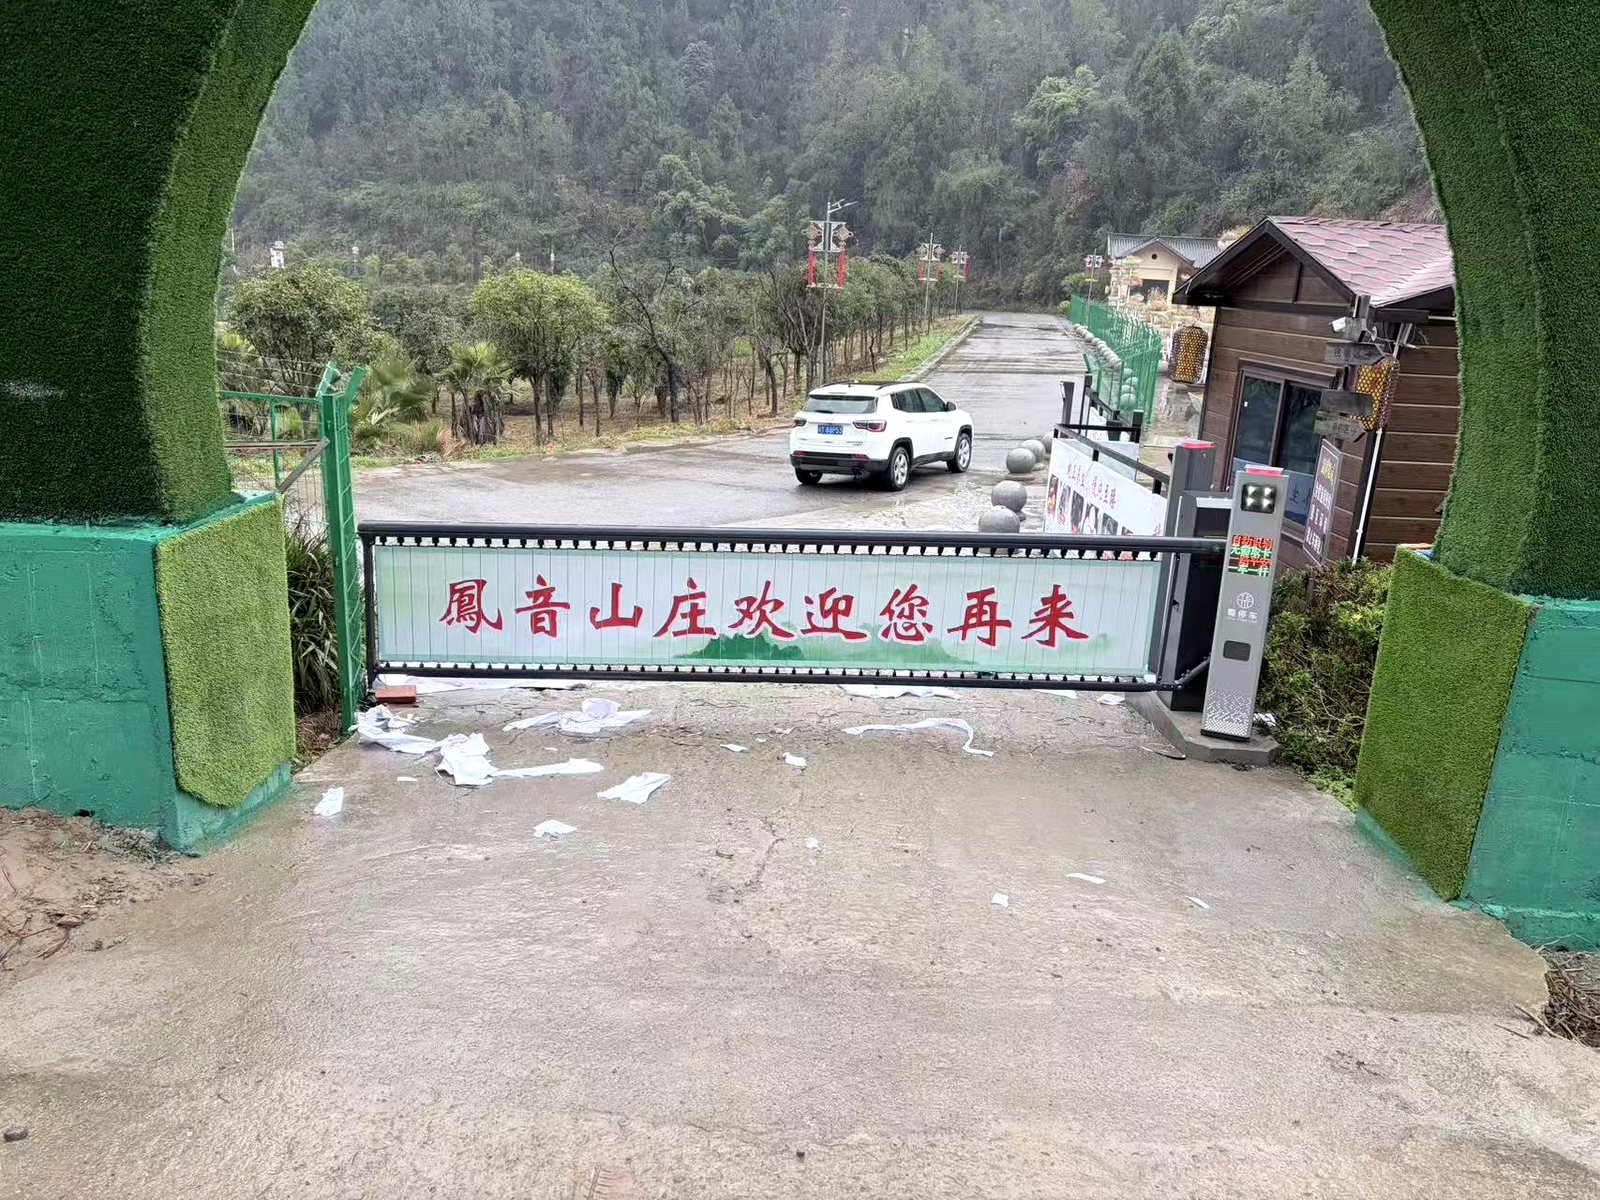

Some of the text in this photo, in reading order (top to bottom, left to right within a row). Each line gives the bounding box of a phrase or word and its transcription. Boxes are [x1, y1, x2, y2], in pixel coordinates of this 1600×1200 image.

[1232, 535, 1273, 550] 自动识别
[1228, 566, 1269, 577] 一车一杆
[439, 575, 1089, 648] 鳳音山庄欢迎您再来
